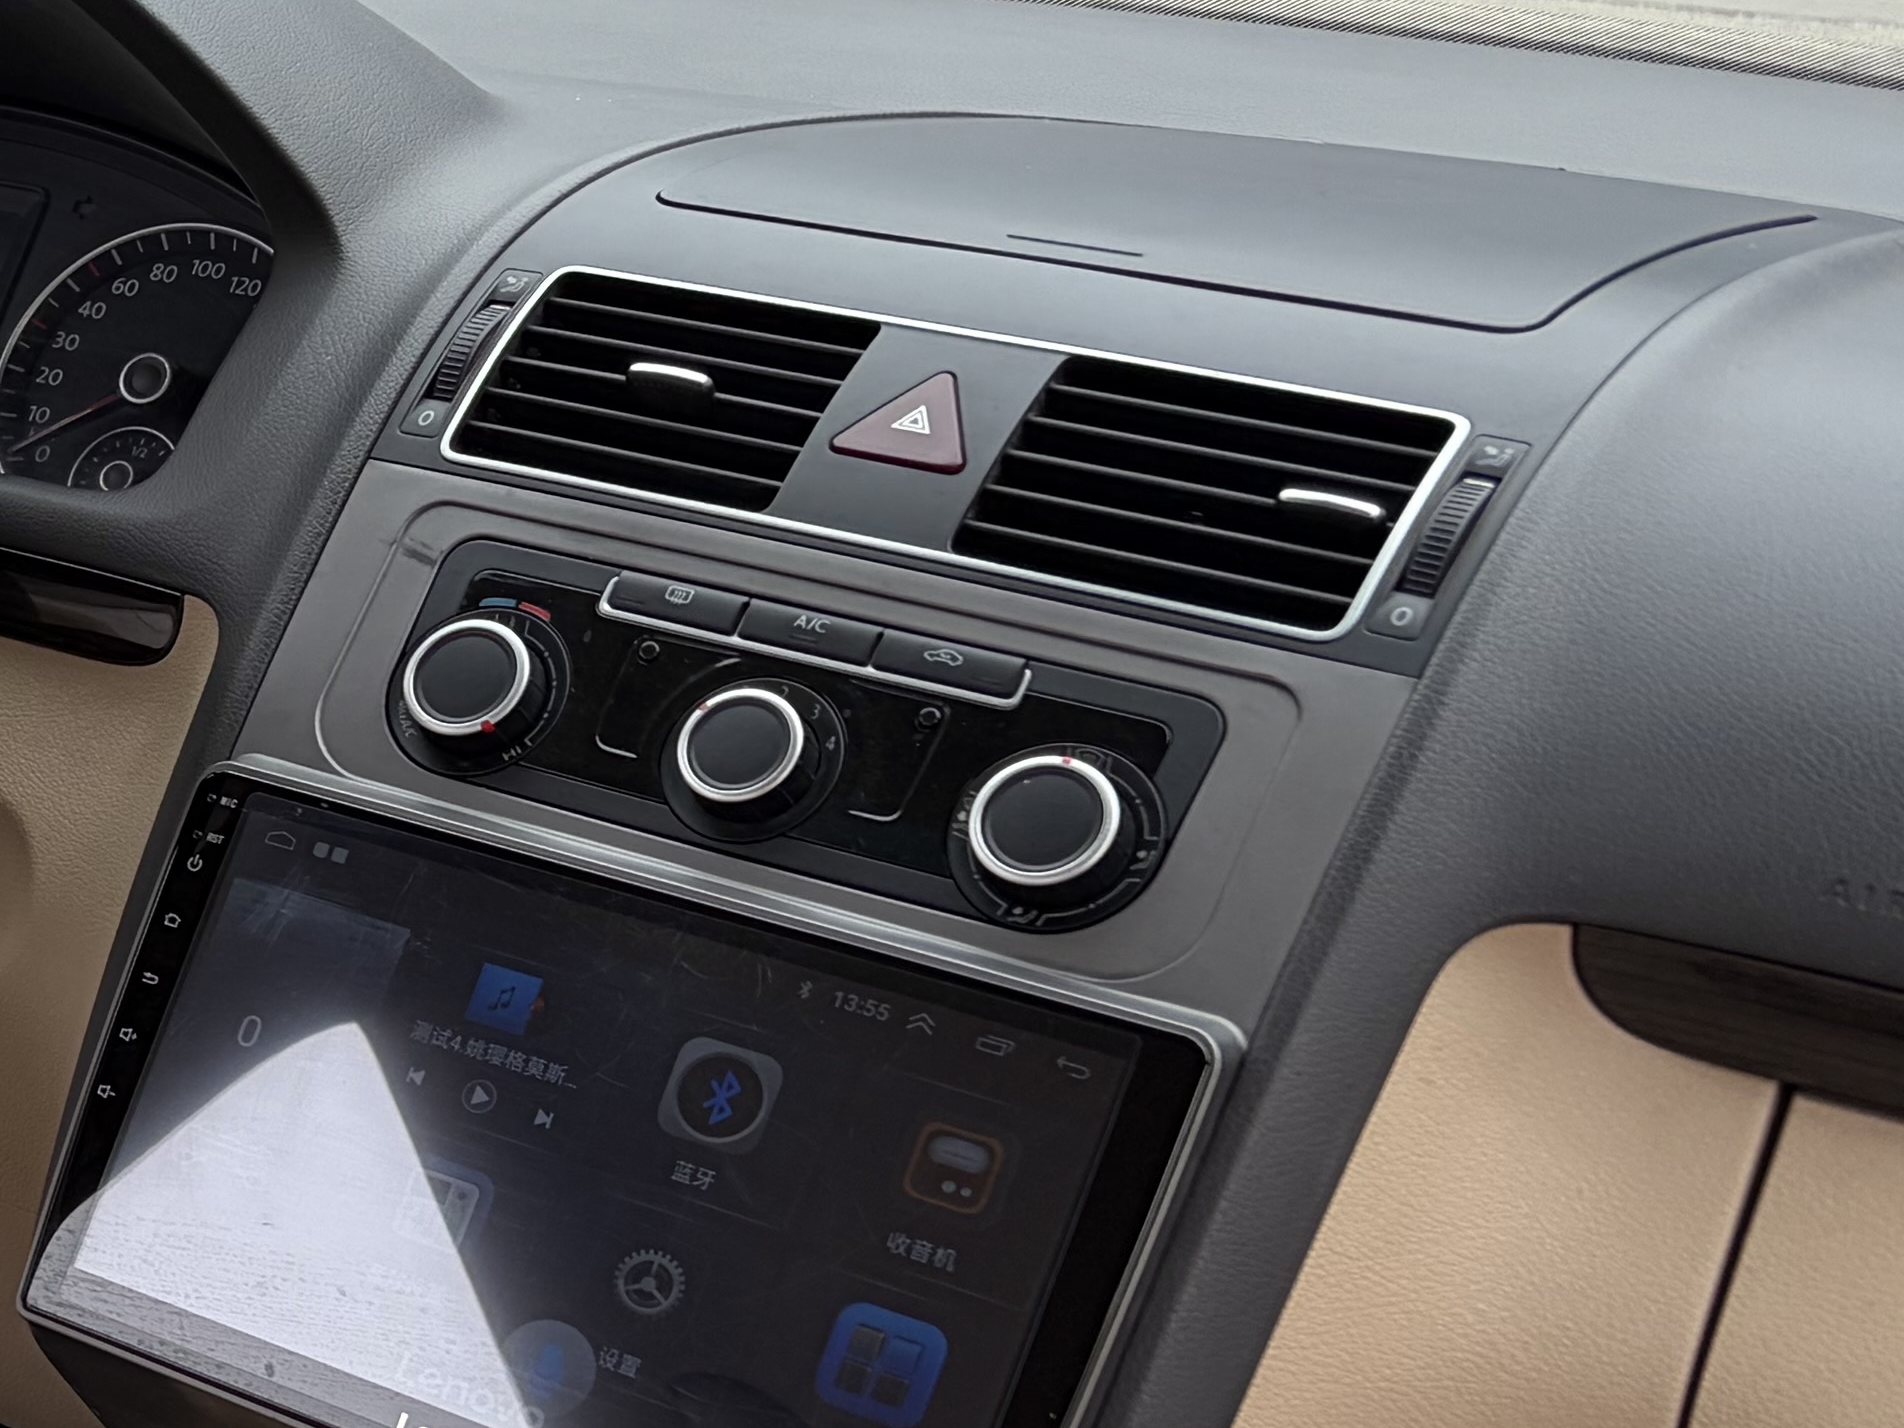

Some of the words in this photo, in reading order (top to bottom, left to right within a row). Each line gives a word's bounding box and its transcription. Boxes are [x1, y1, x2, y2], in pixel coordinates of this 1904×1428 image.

[149, 263, 178, 283] 80
[191, 259, 226, 279] 100
[111, 277, 140, 297] 60
[229, 276, 263, 297] 120
[77, 301, 107, 319] 40
[51, 331, 80, 351] 30
[35, 366, 63, 386] 20
[28, 405, 51, 423] 10
[793, 614, 831, 635] A/C
[219, 795, 239, 809] MIC
[206, 832, 225, 845] RST
[833, 989, 892, 1022] 13:55
[669, 1160, 717, 1191] 蓝牙
[886, 1231, 959, 1272] 收音机
[597, 1346, 643, 1379] 设置
